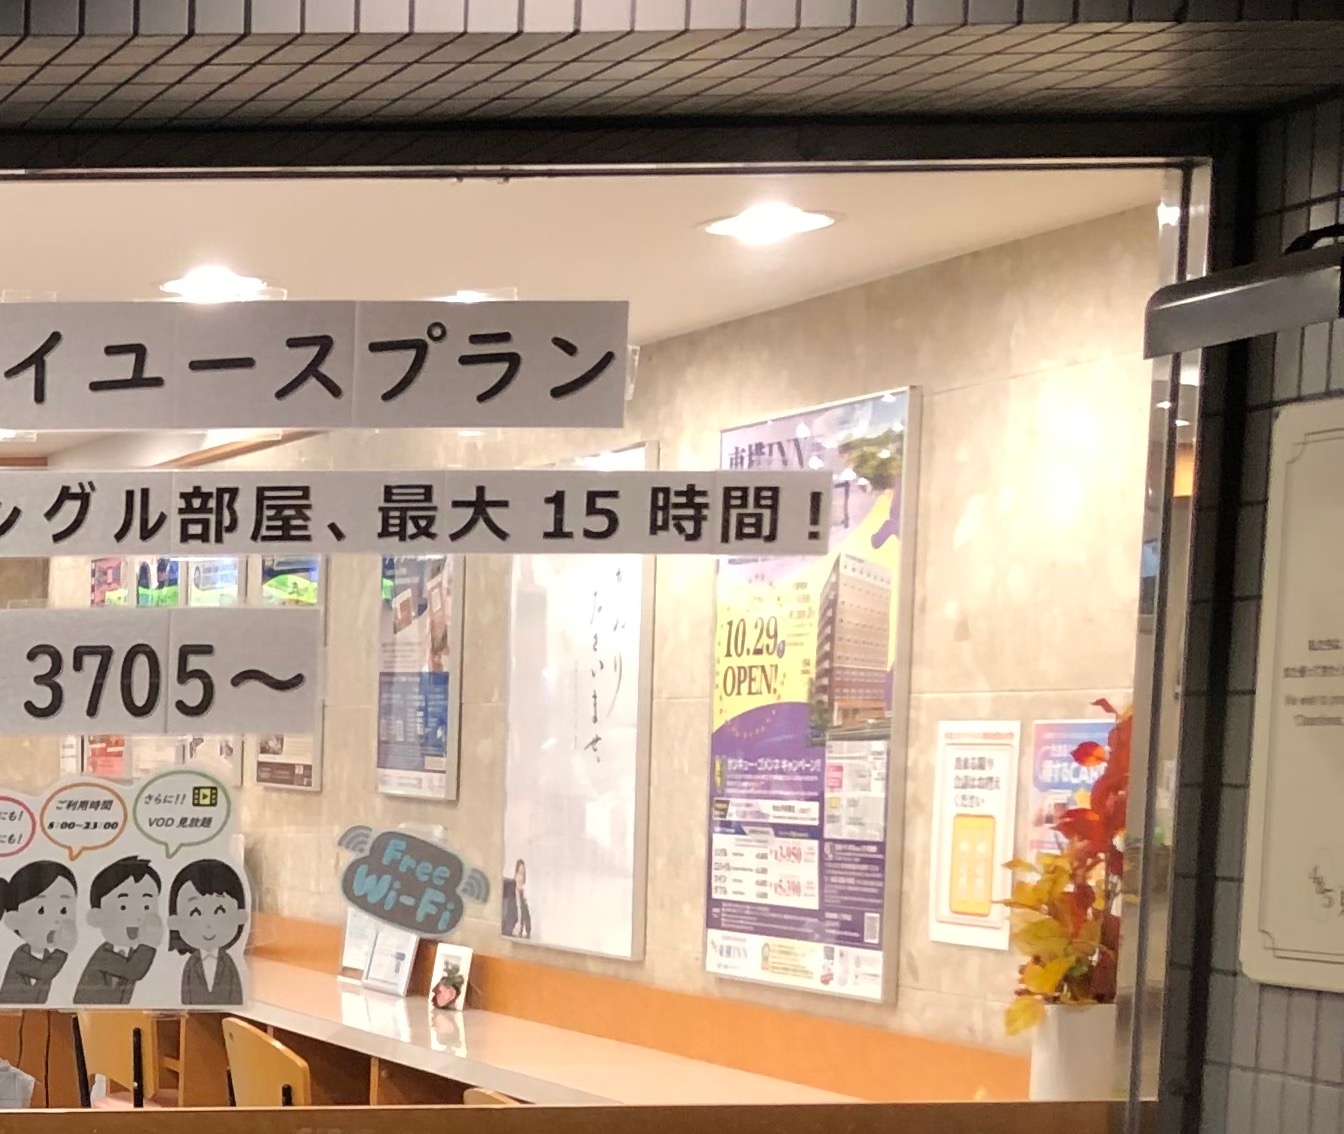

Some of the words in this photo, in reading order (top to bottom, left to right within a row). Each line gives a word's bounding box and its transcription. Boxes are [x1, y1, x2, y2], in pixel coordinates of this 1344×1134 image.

[55, 799, 114, 811] ご利用時間
[148, 816, 176, 828] VOD
[382, 836, 452, 886] Free
[352, 862, 457, 932] Wi-Fi
